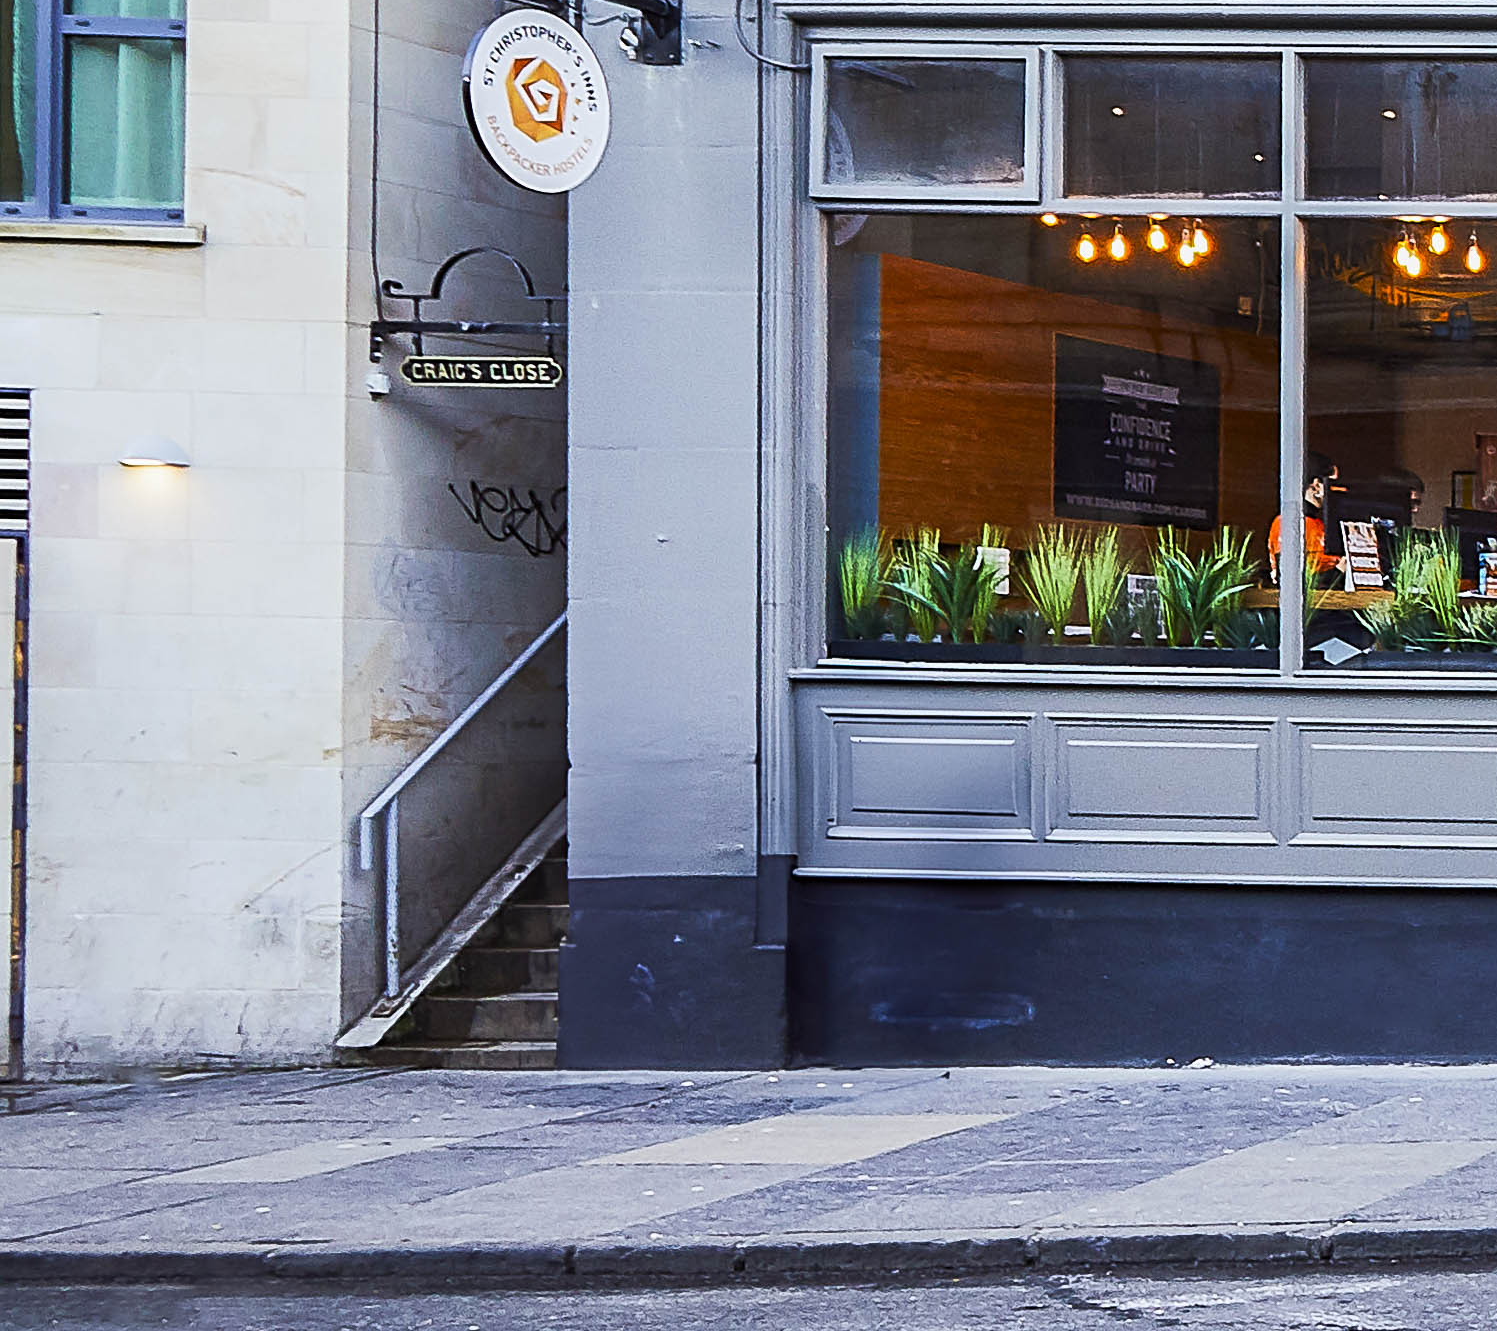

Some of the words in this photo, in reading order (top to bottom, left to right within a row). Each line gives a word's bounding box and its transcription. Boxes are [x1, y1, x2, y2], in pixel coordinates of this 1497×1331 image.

[484, 66, 497, 87] ST
[488, 114, 552, 177] BACKPACKER
[554, 138, 594, 176] HOSTELS
[489, 363, 551, 381] CLOSE
